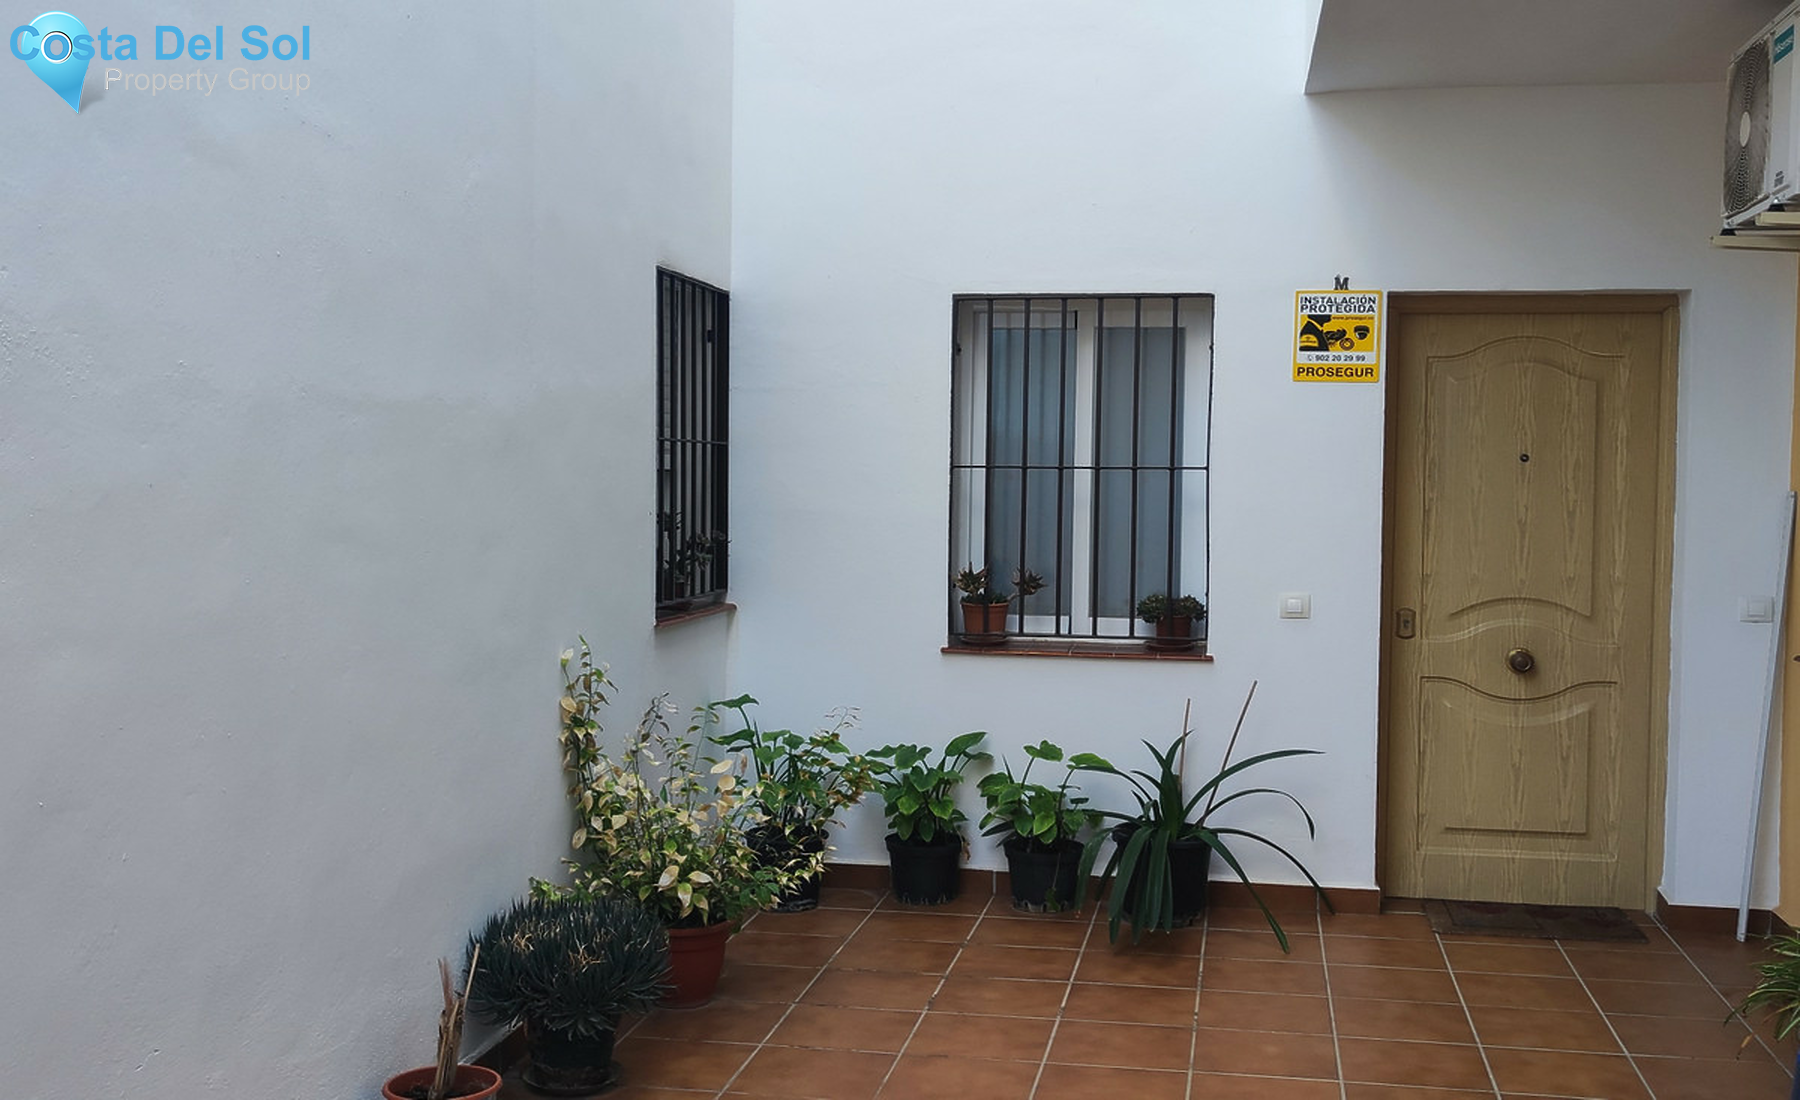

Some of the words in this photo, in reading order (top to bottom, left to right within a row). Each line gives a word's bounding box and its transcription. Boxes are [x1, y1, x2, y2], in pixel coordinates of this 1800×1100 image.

[1300, 295, 1376, 304] INSTALACIÓN
[1300, 304, 1375, 313] PROTEGIDA
[1315, 354, 1330, 362] 902
[1332, 354, 1341, 362] 20
[1343, 354, 1354, 362] 29
[1355, 354, 1366, 362] 99
[1297, 367, 1374, 377] PROSEGUR
